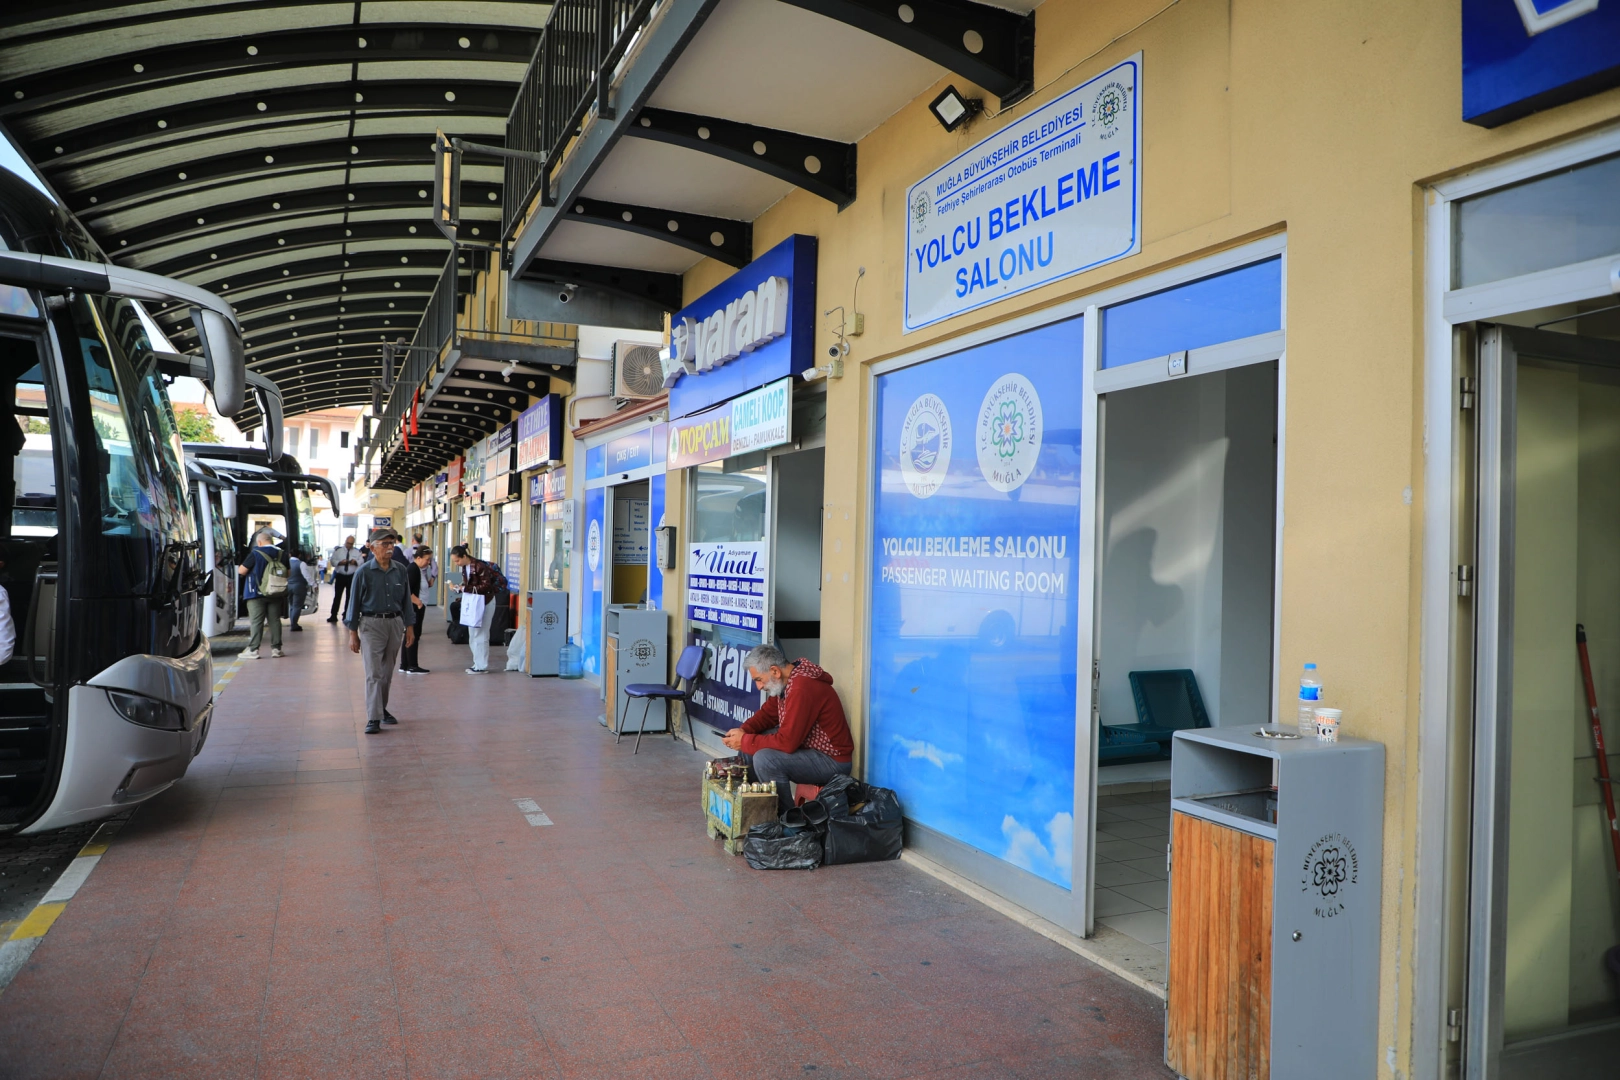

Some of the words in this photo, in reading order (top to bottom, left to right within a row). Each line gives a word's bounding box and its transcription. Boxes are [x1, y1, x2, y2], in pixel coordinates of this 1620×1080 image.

[936, 172, 963, 197] MUĞLA
[963, 140, 1019, 181] BÜYÜKŞEHİR
[1021, 102, 1083, 149] BELEDİYESİ
[937, 196, 960, 217] Fethiye
[961, 174, 1006, 204] Şehirlerarası
[1007, 156, 1038, 178] Otobüs
[1039, 132, 1081, 162] Terminali
[915, 217, 981, 274] YOLCU
[988, 151, 1121, 242] BEKLEME
[955, 231, 1054, 298] SALONU
[694, 275, 789, 372] varan
[762, 388, 785, 421] KOOP.
[680, 415, 730, 456] TOPÇAM
[753, 425, 785, 446] PAMUKKALE
[992, 468, 1022, 484] MUĞLA
[704, 545, 758, 575] Ünal
[882, 537, 922, 556] YOLCU
[925, 536, 991, 557] BEKLEME
[994, 535, 1067, 559] SALONU
[881, 565, 947, 586] PASSENGER
[950, 569, 1010, 590] WAITING
[1014, 571, 1064, 594] ROOM
[695, 638, 753, 693] aran
[706, 690, 730, 717] İSTANBUL
[1314, 903, 1345, 918] MUĞLA
